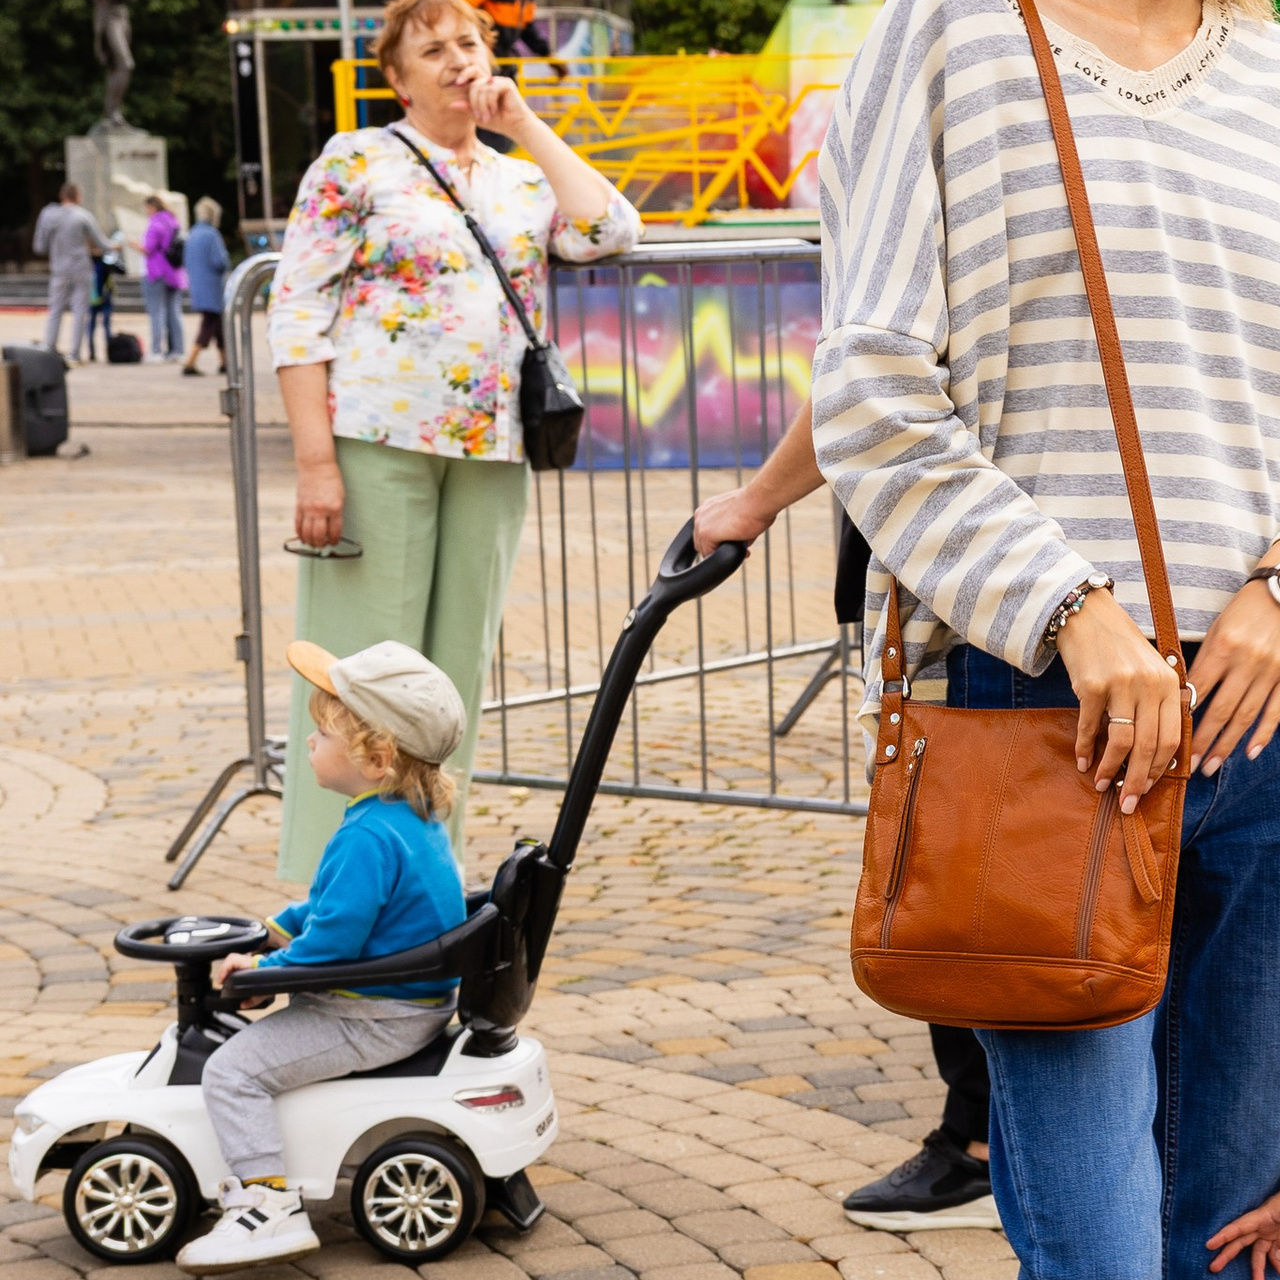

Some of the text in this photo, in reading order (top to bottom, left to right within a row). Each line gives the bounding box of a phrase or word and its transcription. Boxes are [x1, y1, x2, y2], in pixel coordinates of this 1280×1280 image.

[1074, 61, 1108, 87] LOVE
[1118, 87, 1142, 102] LOV
[1171, 72, 1193, 92] LOVE
